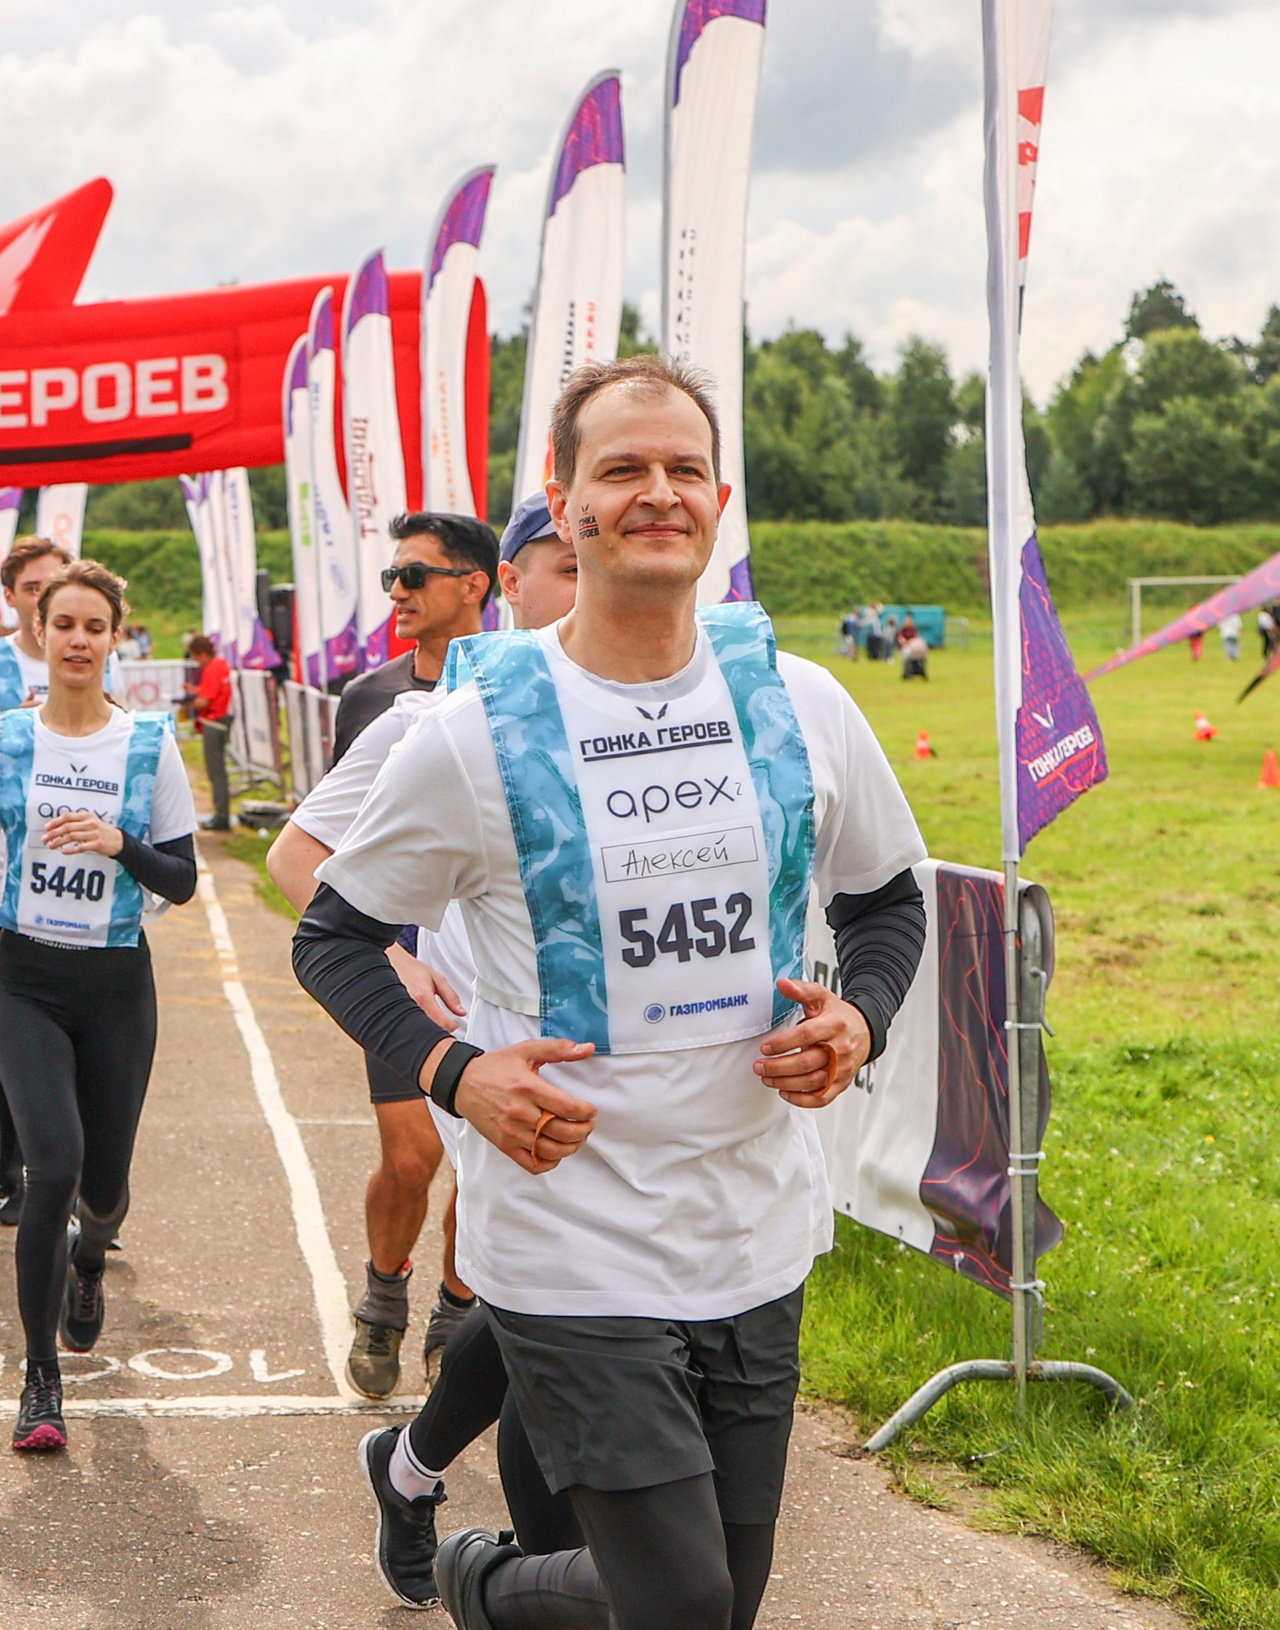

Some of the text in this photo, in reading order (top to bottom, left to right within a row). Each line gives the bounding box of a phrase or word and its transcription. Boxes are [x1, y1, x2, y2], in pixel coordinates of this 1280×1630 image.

[580, 720, 731, 756] ГОНКА ГЕРОЕВ
[35, 773, 119, 792] ГОНКА ГЕРОЕВ
[607, 775, 735, 823] apex
[734, 782, 743, 796] 2
[621, 834, 728, 876] Алексей
[30, 862, 106, 902] 5440
[46, 918, 91, 931] ГАЗПРОМБАНК
[618, 892, 756, 968] 5452
[670, 994, 748, 1016] ГАЗПРОМБАНК
